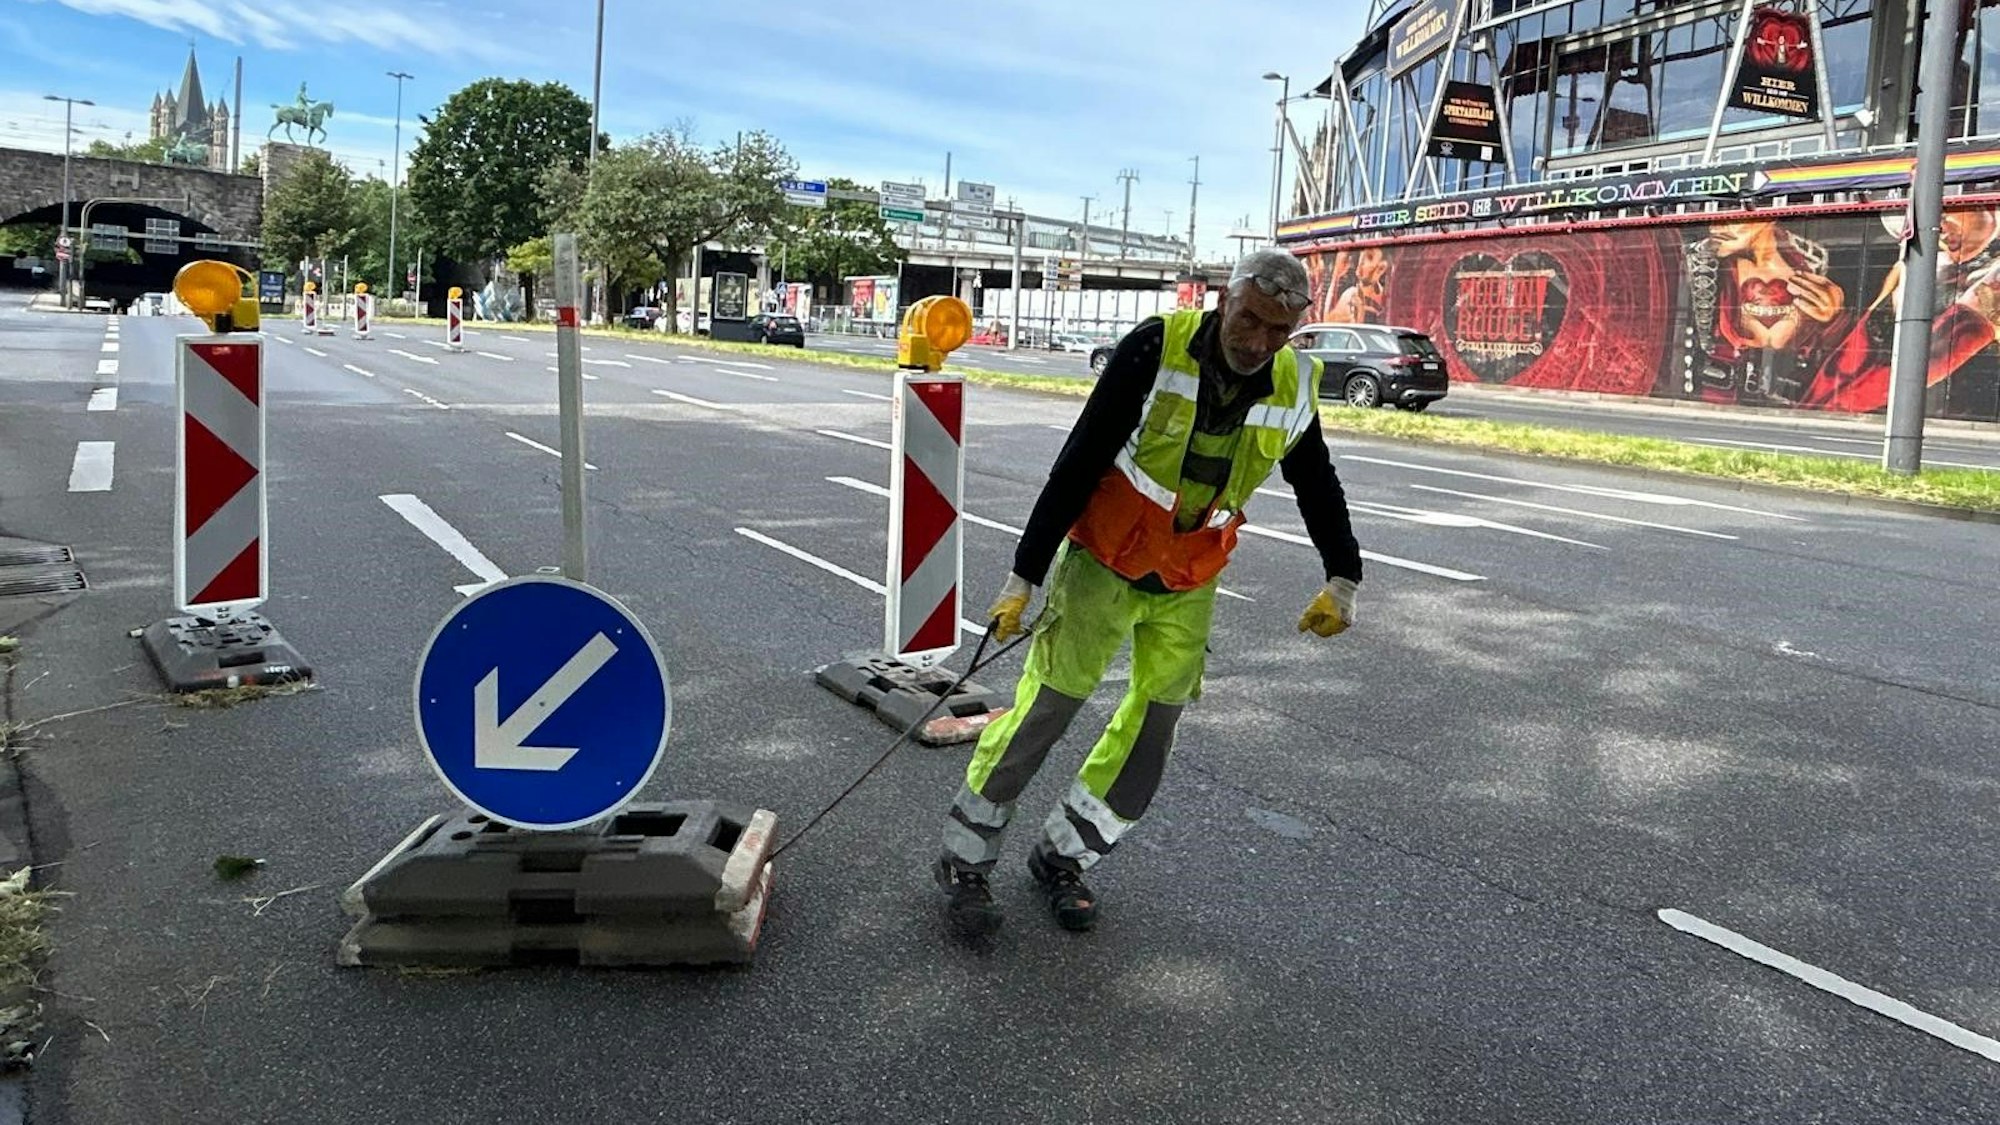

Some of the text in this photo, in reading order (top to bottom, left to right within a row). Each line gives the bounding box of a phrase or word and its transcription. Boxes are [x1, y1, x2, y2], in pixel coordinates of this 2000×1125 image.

[1760, 76, 1796, 91] HIER
[1742, 91, 1809, 113] WILLKOMMEN
[1359, 172, 1748, 228] HIER SEID IHR WILLKOMMEN
